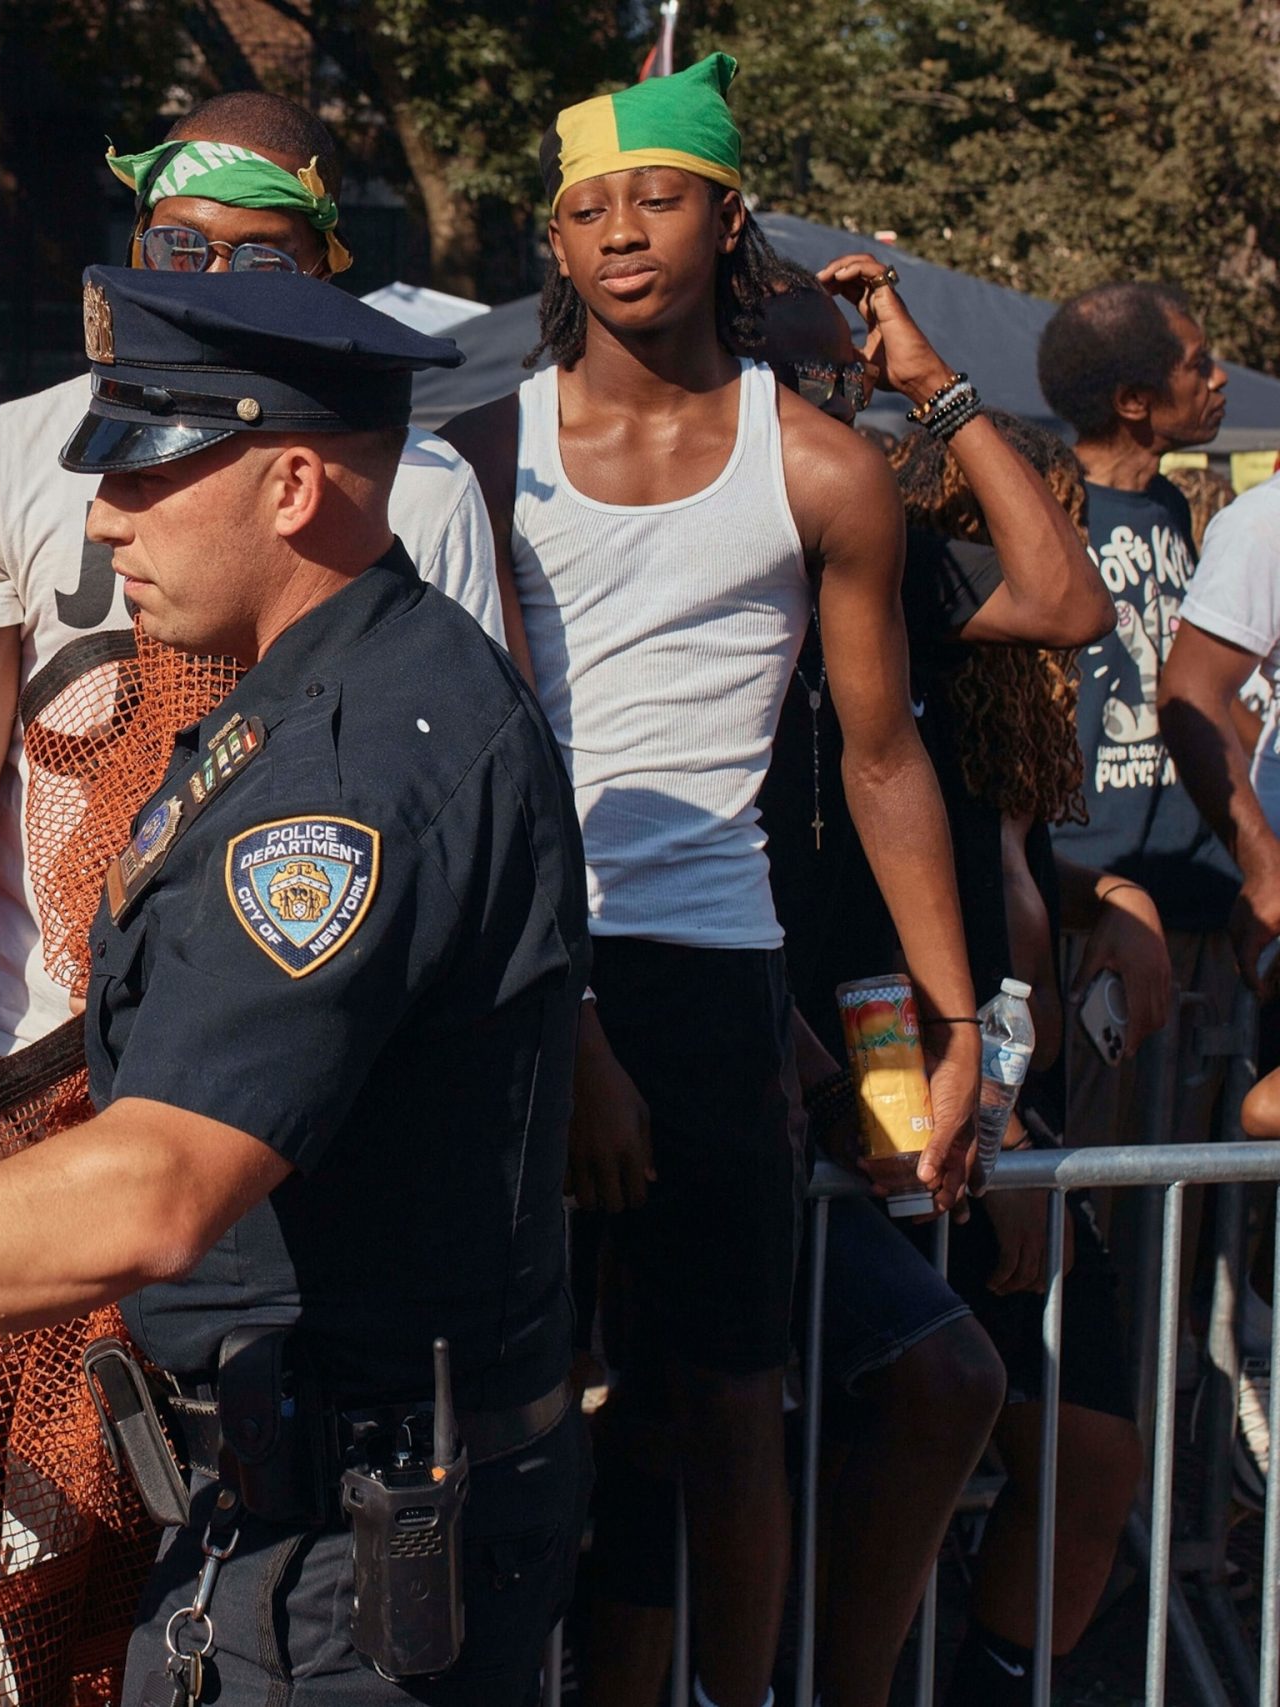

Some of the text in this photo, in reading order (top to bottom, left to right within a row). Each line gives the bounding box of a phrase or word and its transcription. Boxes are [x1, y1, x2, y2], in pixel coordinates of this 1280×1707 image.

[240, 840, 364, 869] DEPARTMENT
[266, 825, 338, 846] POLICE
[237, 886, 283, 946] CITY OF
[308, 875, 368, 956] NEW YORK
